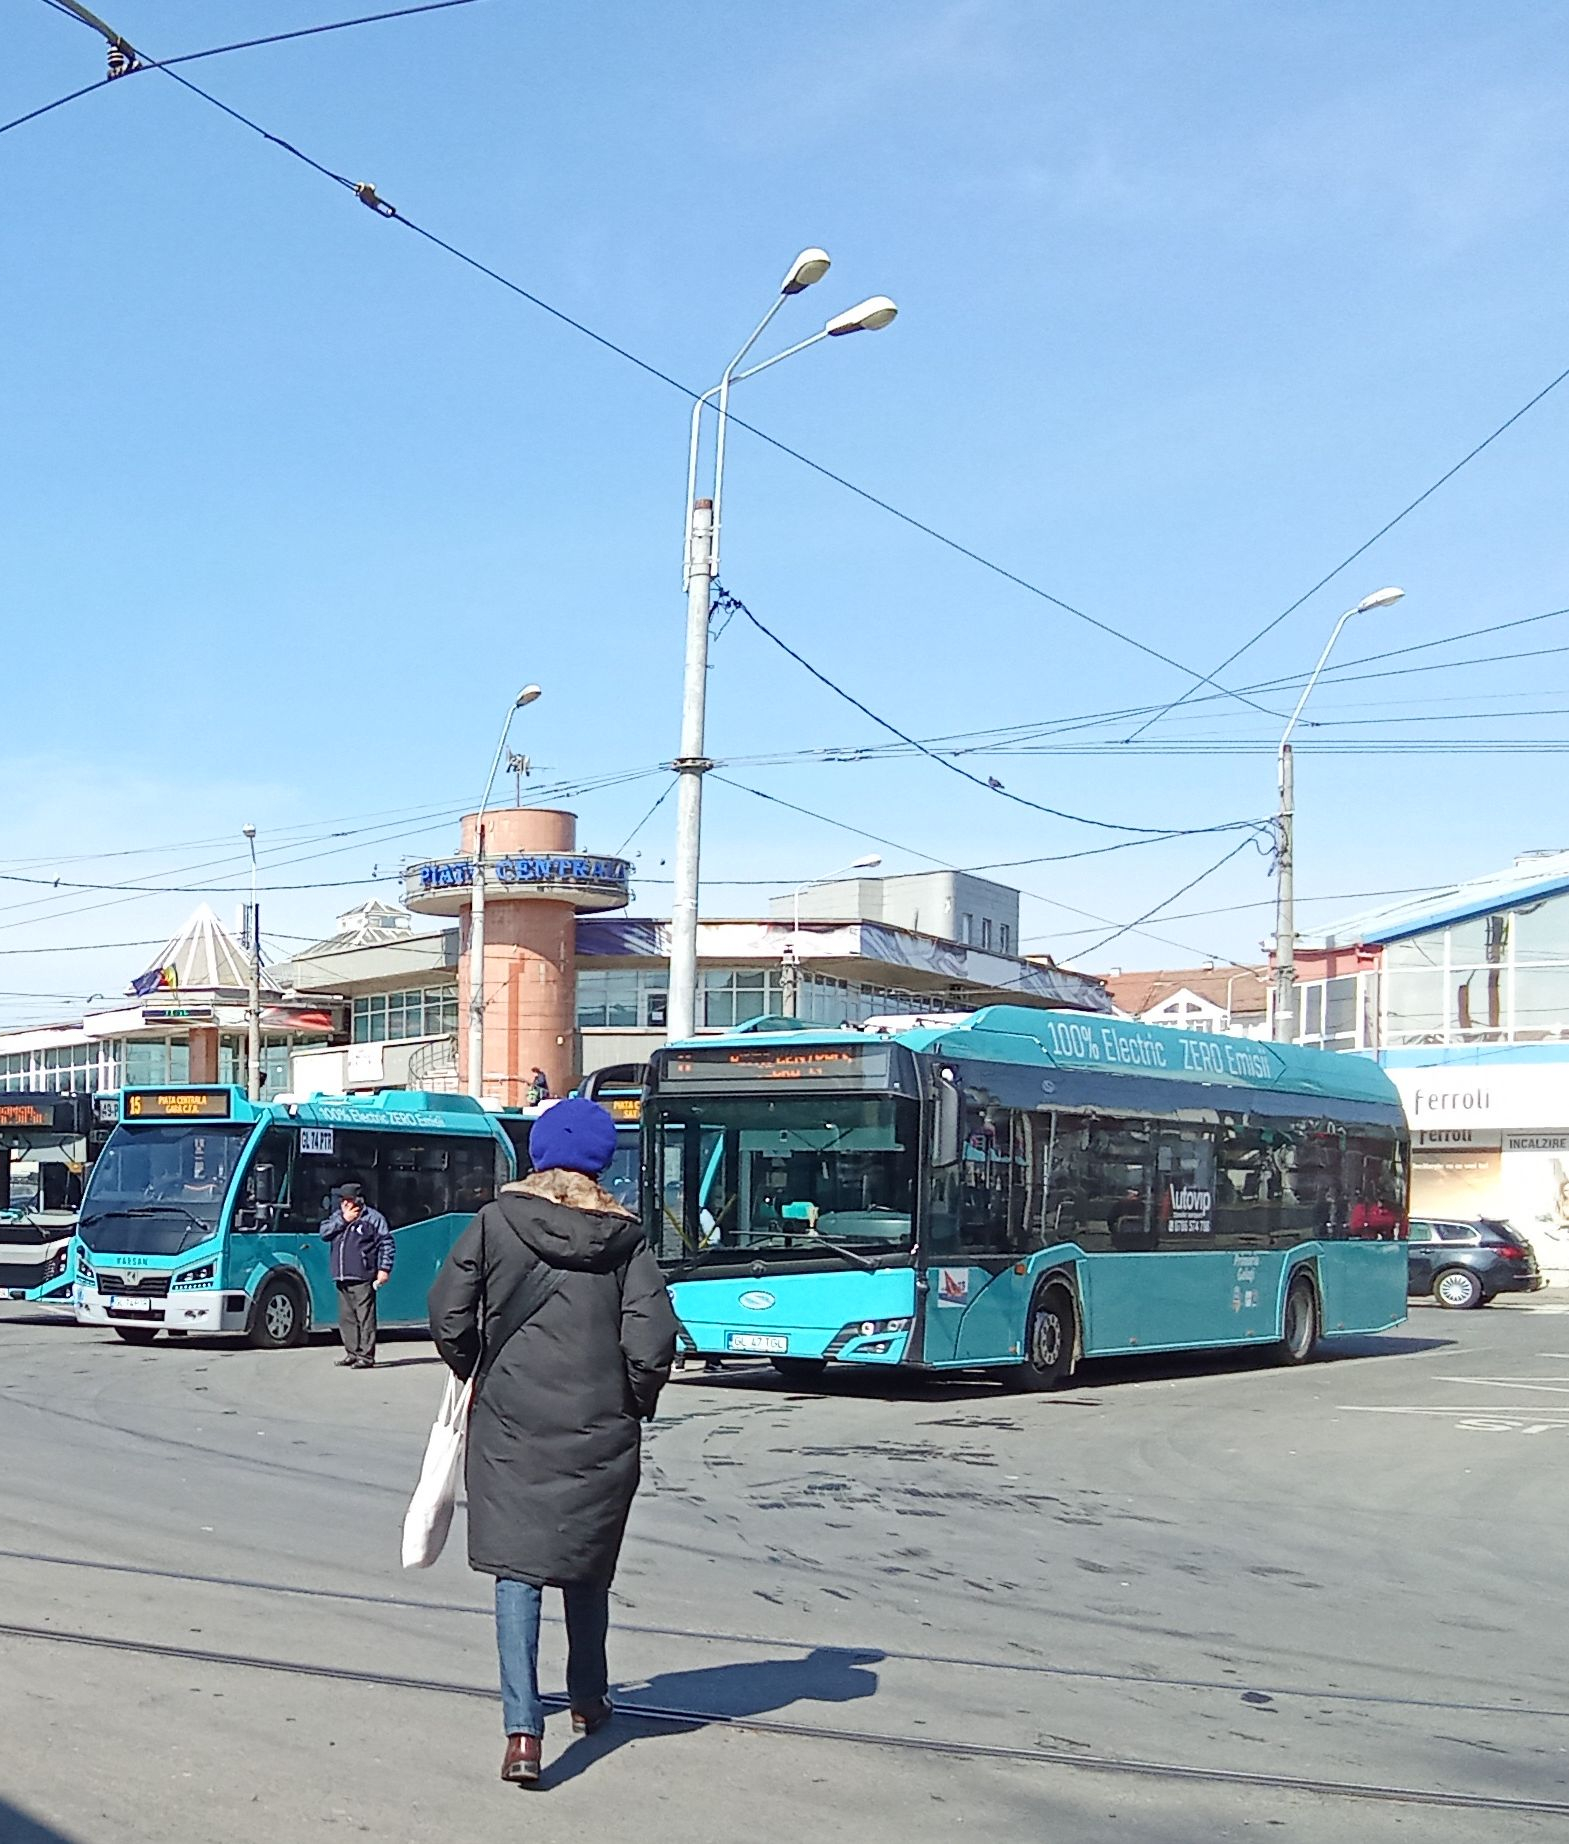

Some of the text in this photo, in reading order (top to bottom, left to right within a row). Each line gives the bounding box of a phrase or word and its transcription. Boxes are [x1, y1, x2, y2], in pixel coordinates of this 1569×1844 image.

[1047, 1022, 1272, 1079] 100% Electric ZERO Emisii
[129, 1096, 141, 1115] 15
[1415, 1088, 1490, 1116] ferroli
[319, 1107, 352, 1122] 100%
[349, 1109, 389, 1125] Electric
[386, 1112, 417, 1126] ZERO
[735, 1336, 747, 1347] GL
